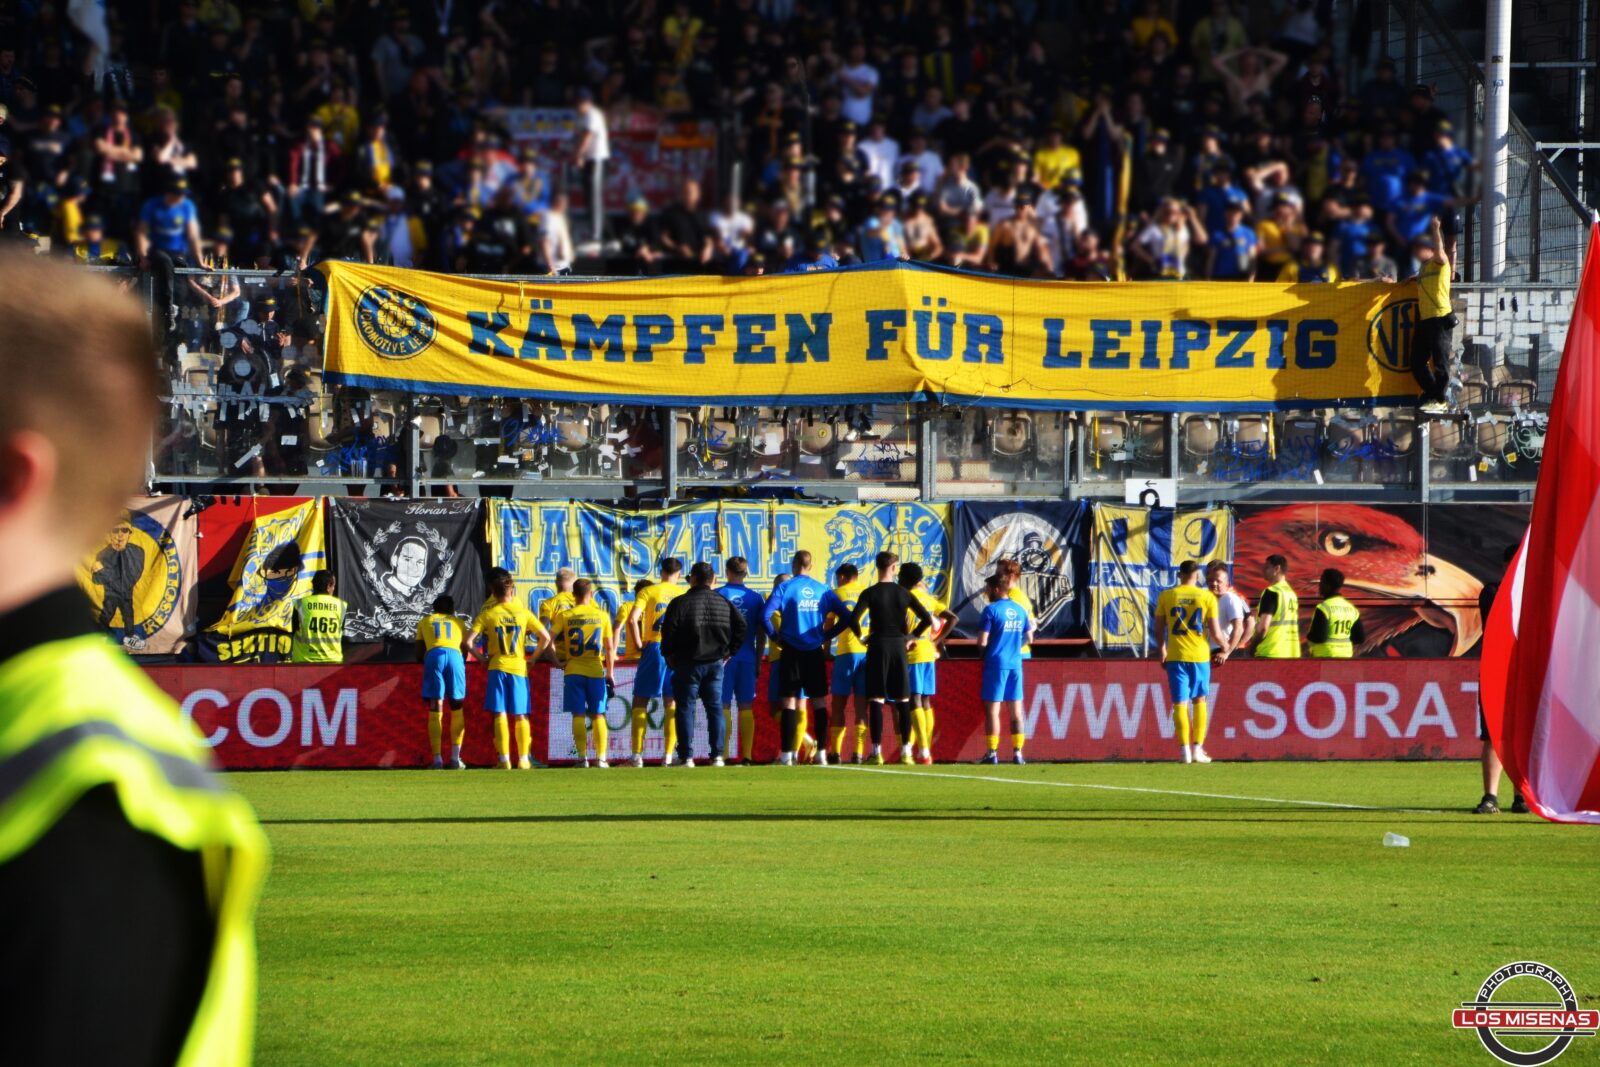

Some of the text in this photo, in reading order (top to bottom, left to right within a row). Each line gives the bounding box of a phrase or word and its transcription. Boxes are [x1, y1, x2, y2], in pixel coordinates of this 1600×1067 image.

[466, 296, 1339, 370] KÄMPFEN FÜR LEIPZIG
[496, 502, 800, 579] FANSZENE
[1094, 564, 1180, 588] FANKU
[307, 601, 338, 612] ORDNER
[798, 599, 820, 608] AMZ
[308, 616, 338, 634] 465
[431, 621, 452, 640] 11
[1170, 607, 1204, 636] 24
[1333, 619, 1352, 636] 119
[216, 634, 292, 662] SEKTIO
[495, 625, 522, 655] 17
[567, 627, 602, 657] 34
